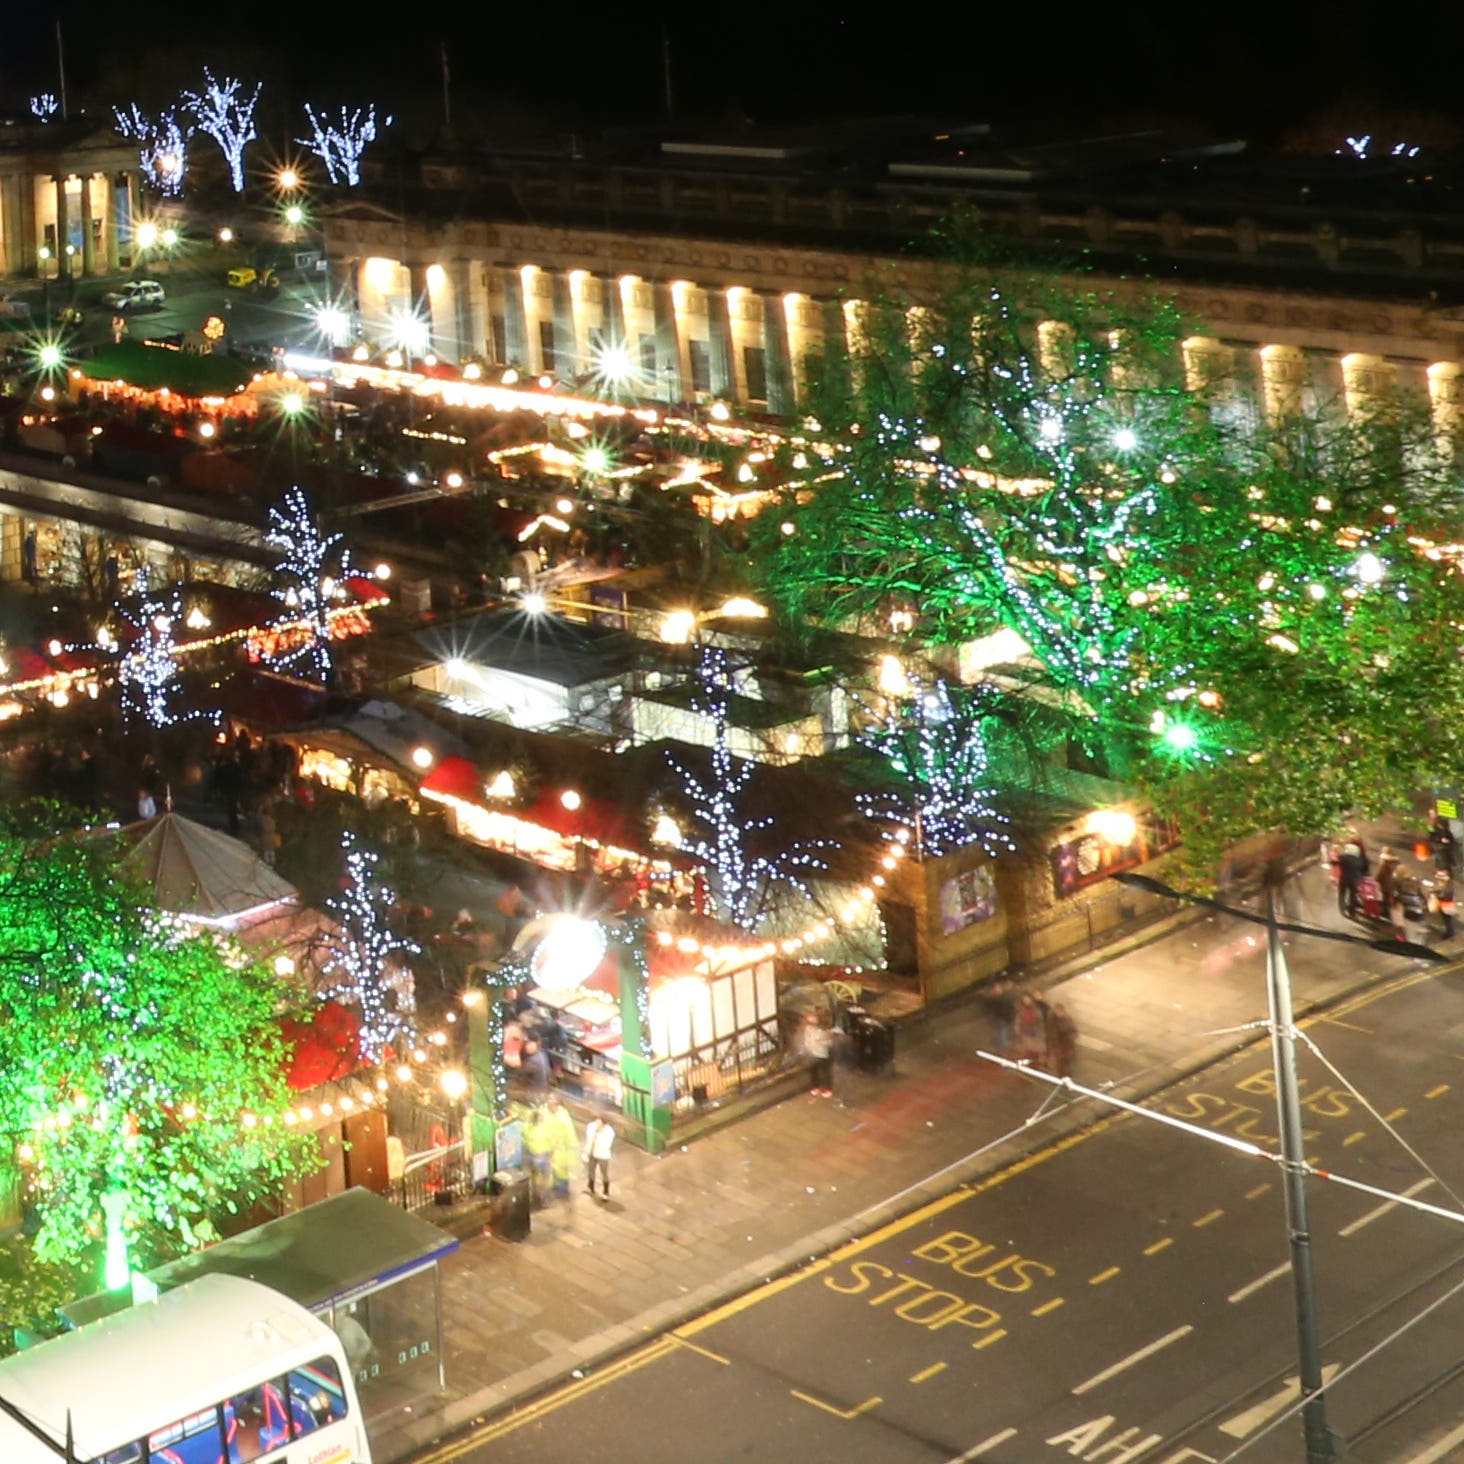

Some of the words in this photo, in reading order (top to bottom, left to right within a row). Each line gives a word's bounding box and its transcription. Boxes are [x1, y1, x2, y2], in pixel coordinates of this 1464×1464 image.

[1166, 1093, 1320, 1145] ST
[912, 1231, 1055, 1292] BUS
[824, 1262, 1001, 1330] STOP
